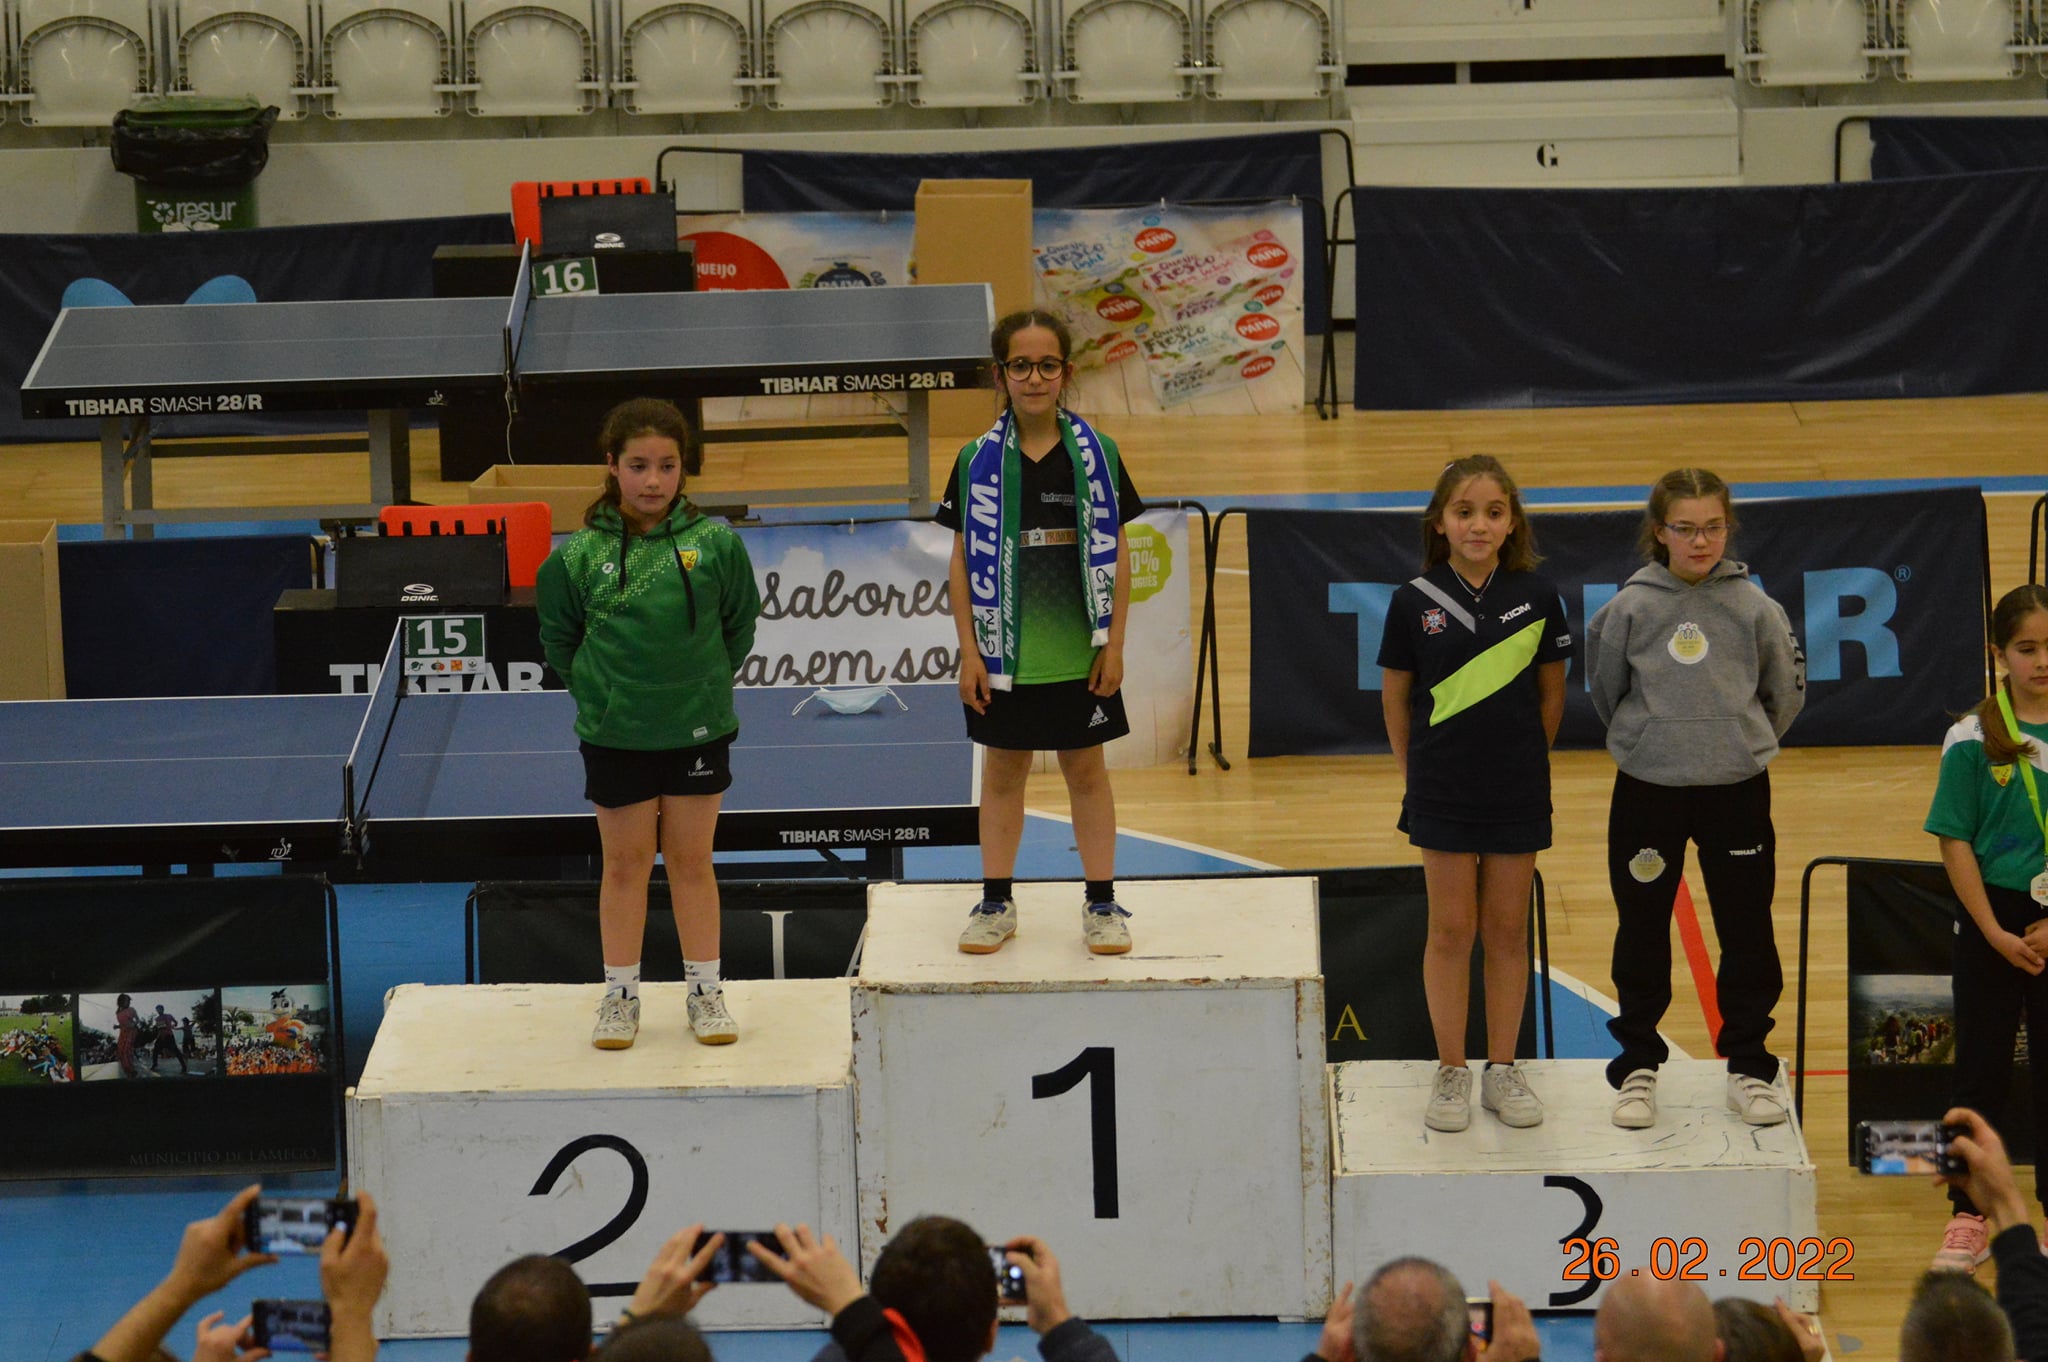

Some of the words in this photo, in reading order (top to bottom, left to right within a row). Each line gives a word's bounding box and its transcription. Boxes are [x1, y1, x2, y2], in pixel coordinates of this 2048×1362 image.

[1537, 143, 1558, 168] G
[176, 202, 237, 221] resur
[1137, 232, 1174, 249] PAIVA
[1250, 248, 1286, 263] PAIVA
[542, 262, 585, 294] 16
[1099, 299, 1141, 317] PAIVA
[1239, 318, 1277, 335] PAIVA
[760, 376, 838, 394] TIBHAR
[843, 374, 904, 391] SMASH
[909, 371, 954, 389] 28/R
[65, 399, 144, 416] TIBHAR
[150, 396, 212, 413] SMASH
[217, 394, 263, 411] 28/R
[1130, 550, 1160, 574] 0%
[1003, 536, 1014, 625] Mirandela
[1499, 603, 1532, 624] XIOM
[417, 619, 467, 655] 15
[1005, 627, 1015, 660] Por
[734, 649, 887, 687] azem
[780, 830, 839, 844] TIBHAR
[843, 828, 891, 841] SMASH
[894, 827, 930, 840] 28/R
[1032, 1046, 1119, 1219] 1
[528, 1134, 649, 1297] 2
[1543, 1175, 1606, 1307] 3
